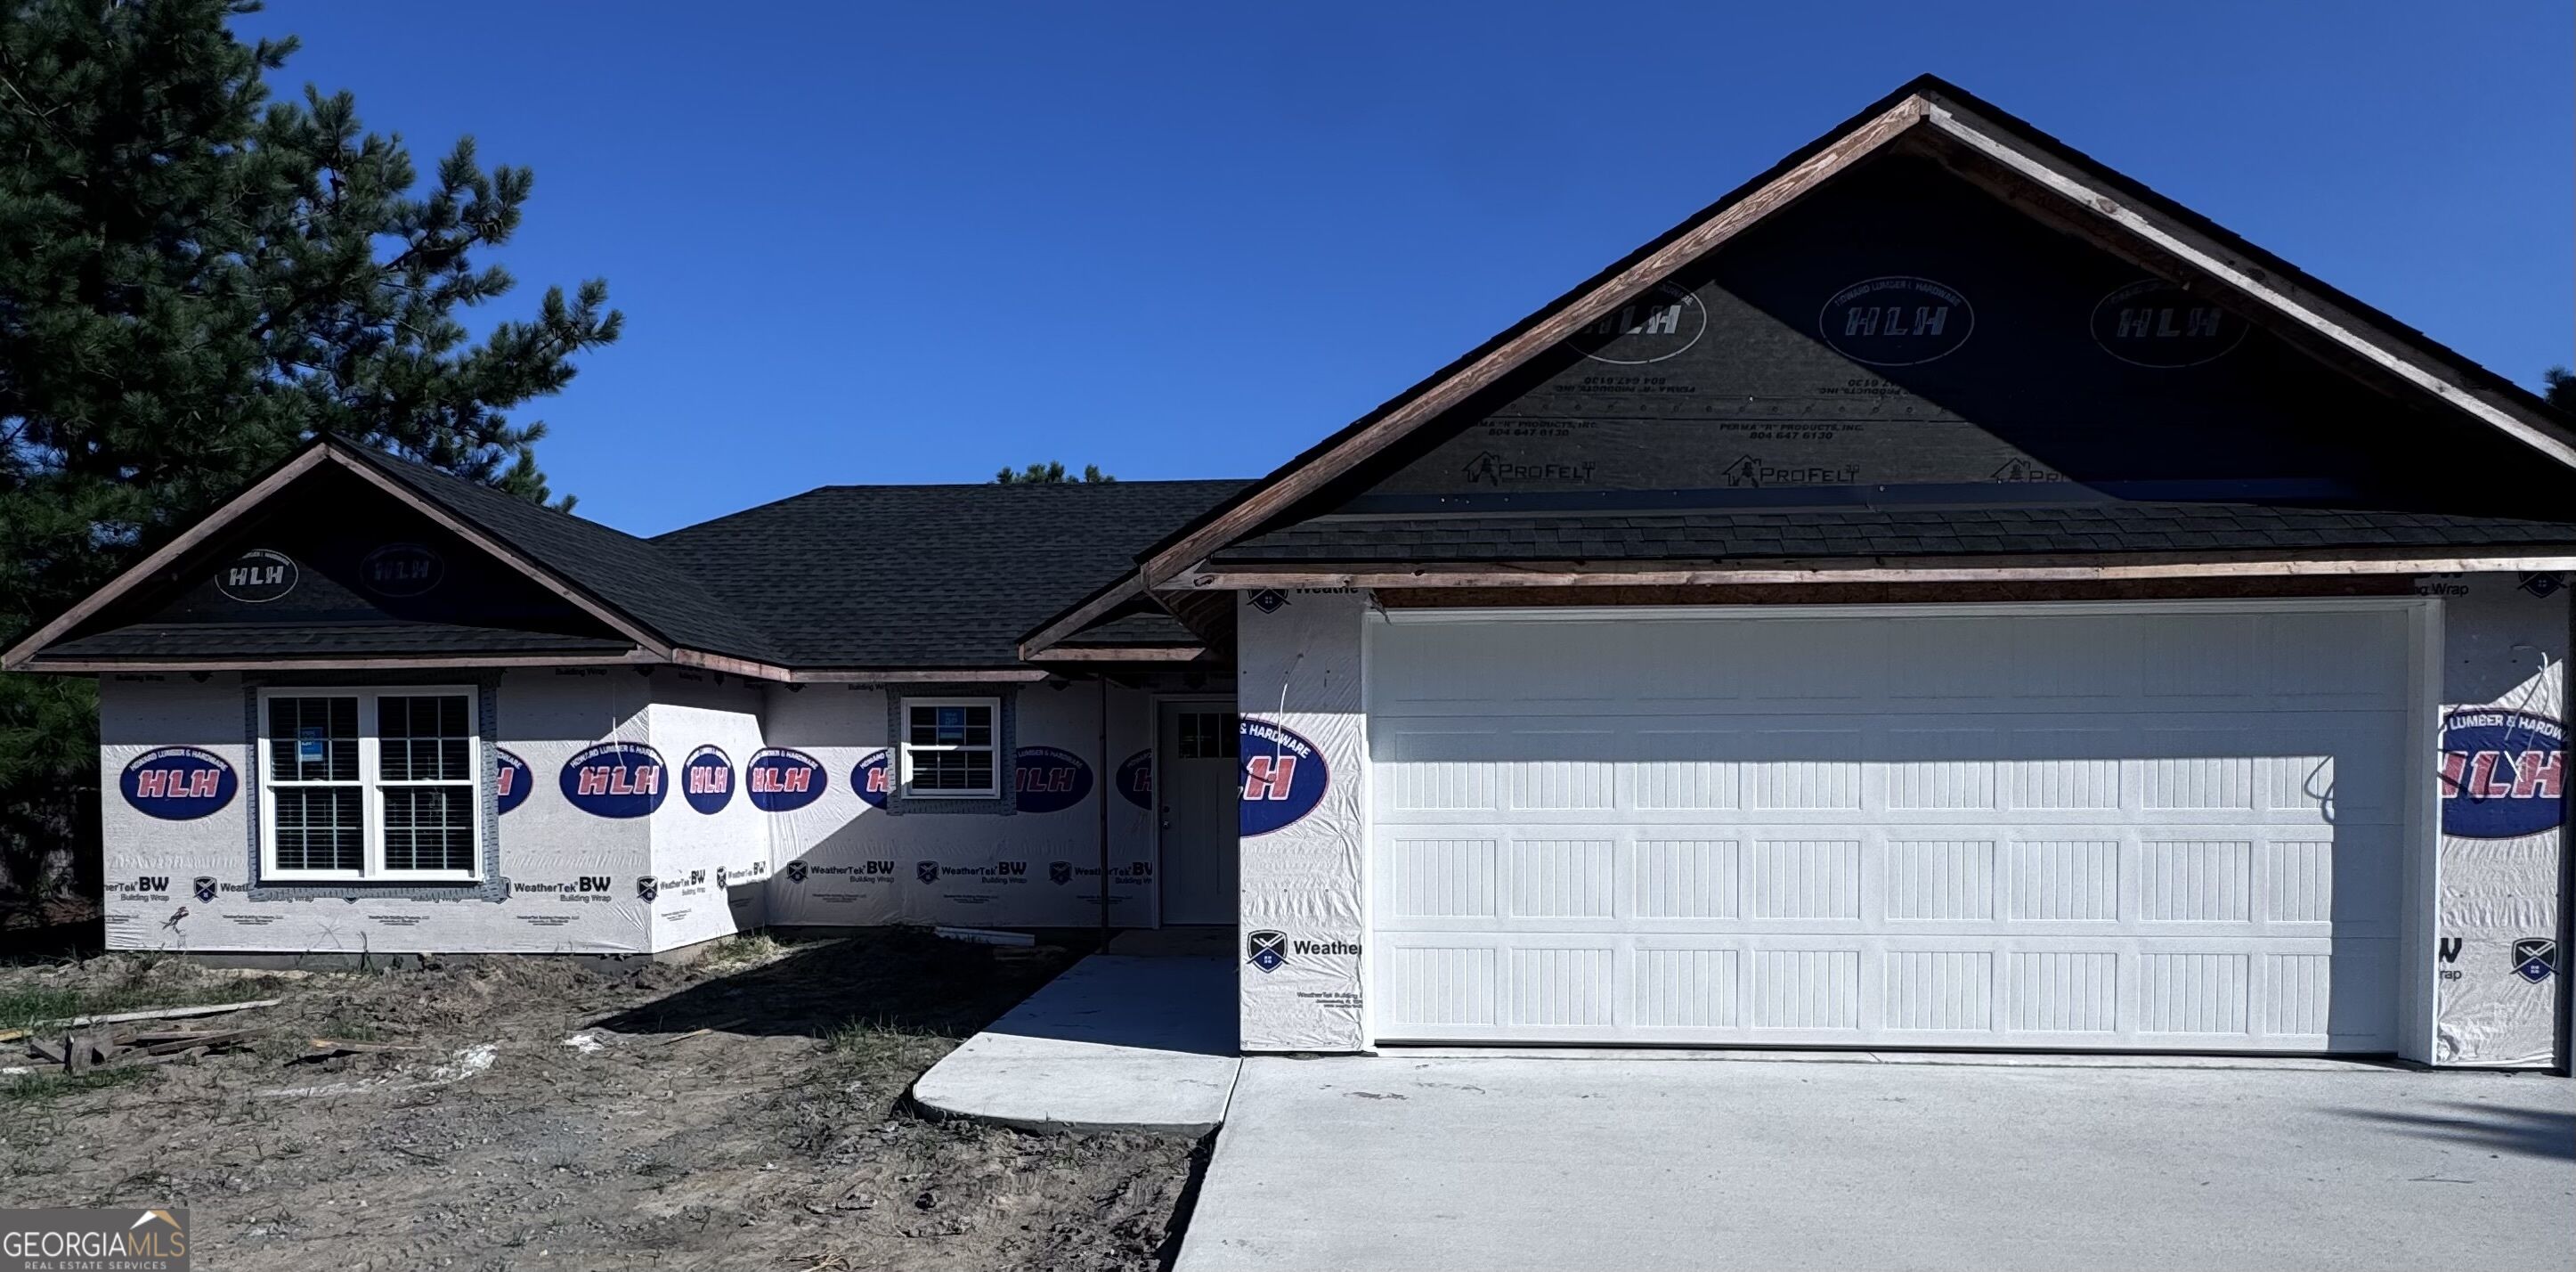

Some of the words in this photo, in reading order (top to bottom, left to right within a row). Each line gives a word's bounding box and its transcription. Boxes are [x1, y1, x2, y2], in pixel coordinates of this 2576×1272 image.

[1845, 306, 1949, 336] HLH
[2117, 307, 2223, 338] HLH
[229, 566, 284, 585] HLH
[2432, 583, 2469, 597] Wrap
[2449, 714, 2503, 730] LUMBER
[2506, 715, 2516, 727] &
[1239, 722, 1247, 734] &
[1249, 724, 1312, 759] HARDWARE
[137, 769, 220, 797] HLH
[577, 765, 660, 795] HLH
[690, 766, 728, 794] HLH
[752, 767, 812, 793] HLH
[866, 860, 895, 874] BW
[998, 861, 1027, 875] BW
[138, 877, 170, 892] BW
[514, 883, 577, 893] WeatherTek
[579, 877, 611, 892] BW
[691, 868, 706, 885] BW
[2440, 969, 2462, 982] rap
